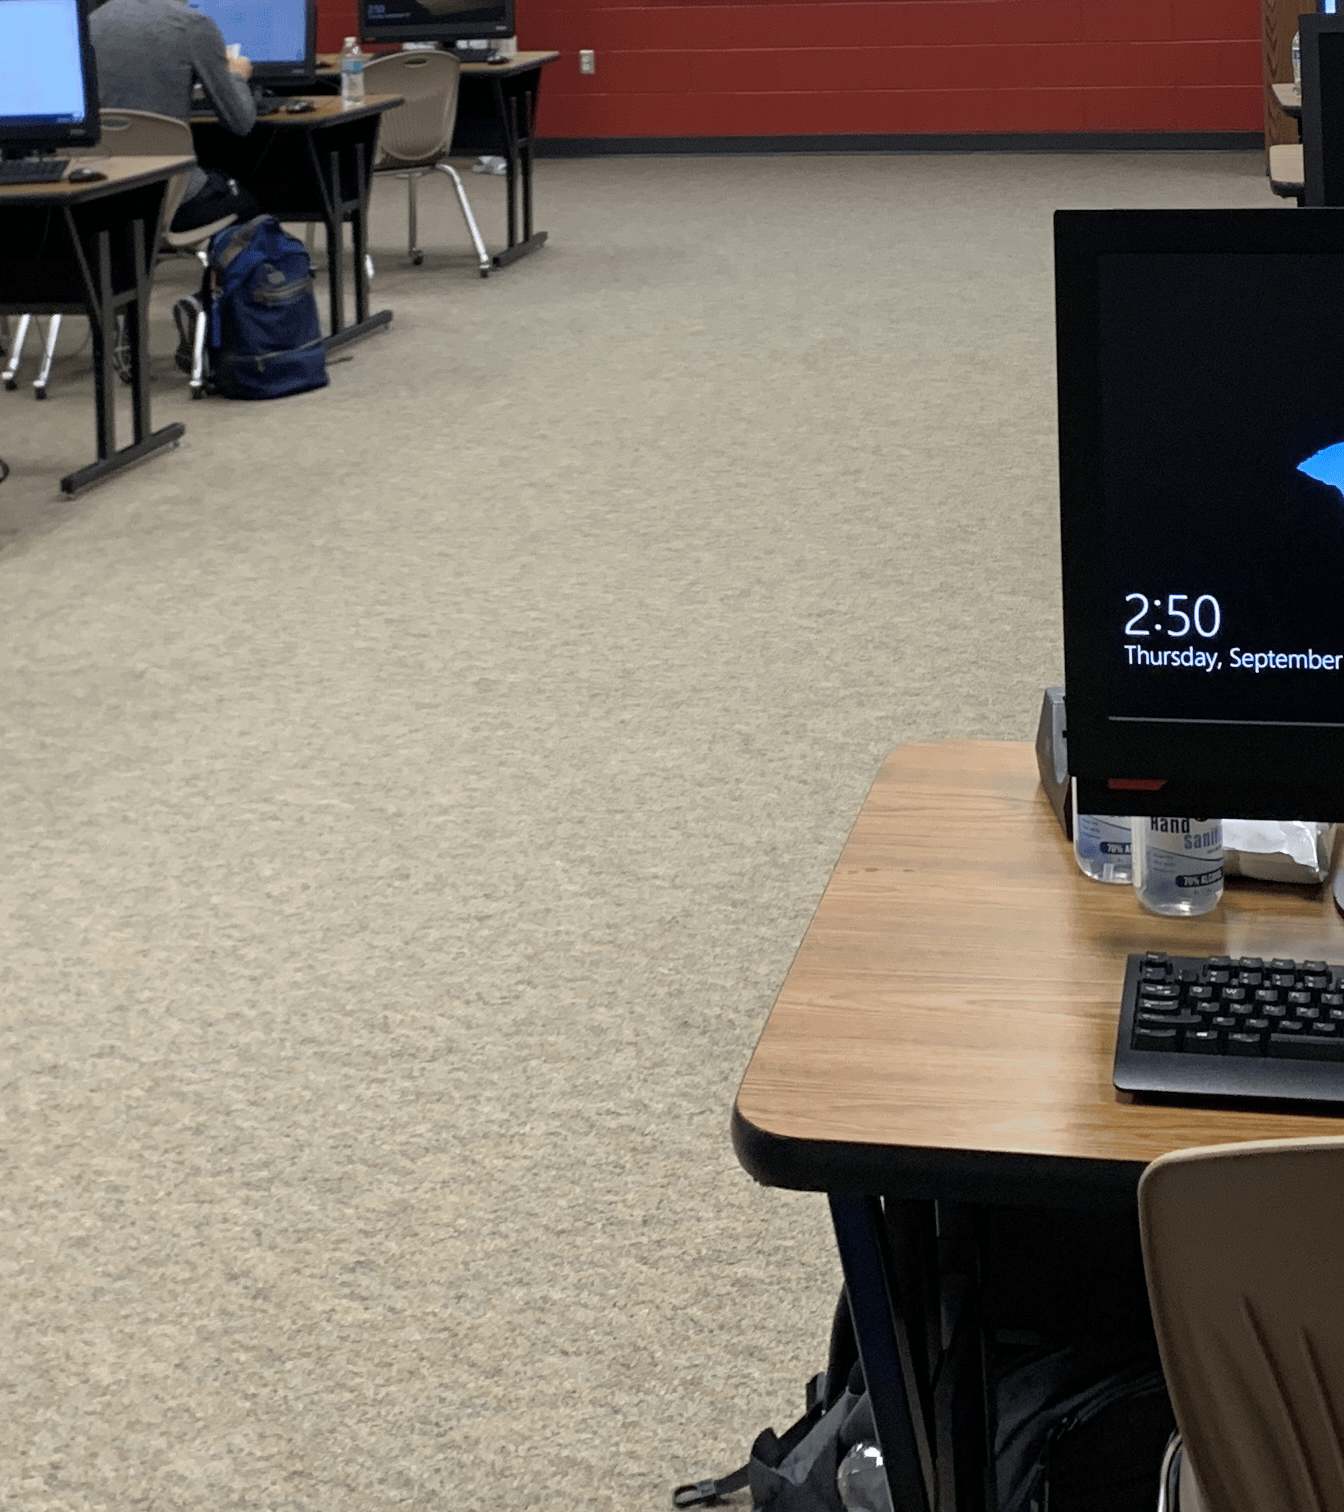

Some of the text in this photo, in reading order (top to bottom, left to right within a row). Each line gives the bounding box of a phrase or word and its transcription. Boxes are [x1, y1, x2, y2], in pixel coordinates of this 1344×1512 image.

[1124, 592, 1221, 638] 2:50
[1123, 644, 1223, 672] Thursday,
[1229, 647, 1343, 673] September
[1150, 816, 1191, 833] Hand
